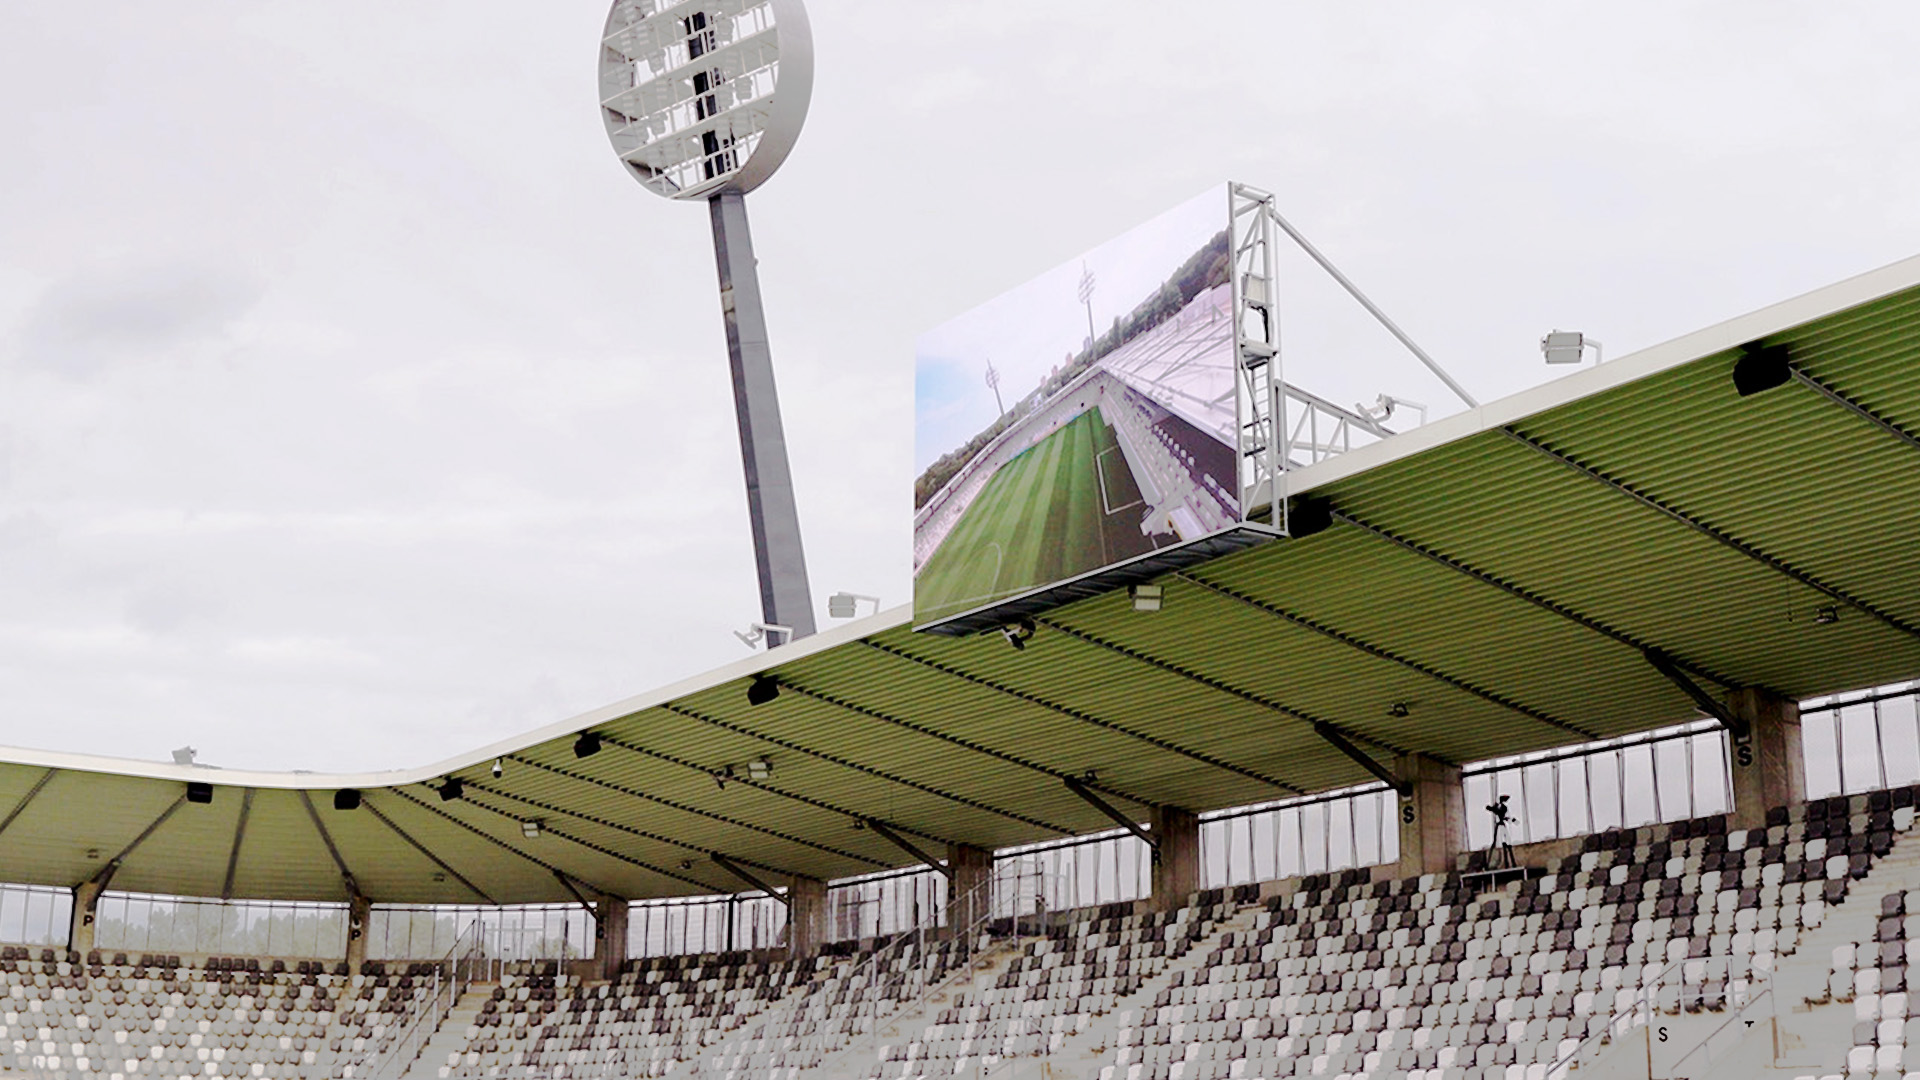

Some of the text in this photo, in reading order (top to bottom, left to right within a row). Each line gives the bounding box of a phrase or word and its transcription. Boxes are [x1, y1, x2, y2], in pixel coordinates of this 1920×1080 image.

[1738, 746, 1753, 767] S
[1402, 806, 1415, 824] S
[1658, 1026, 1668, 1042] S
